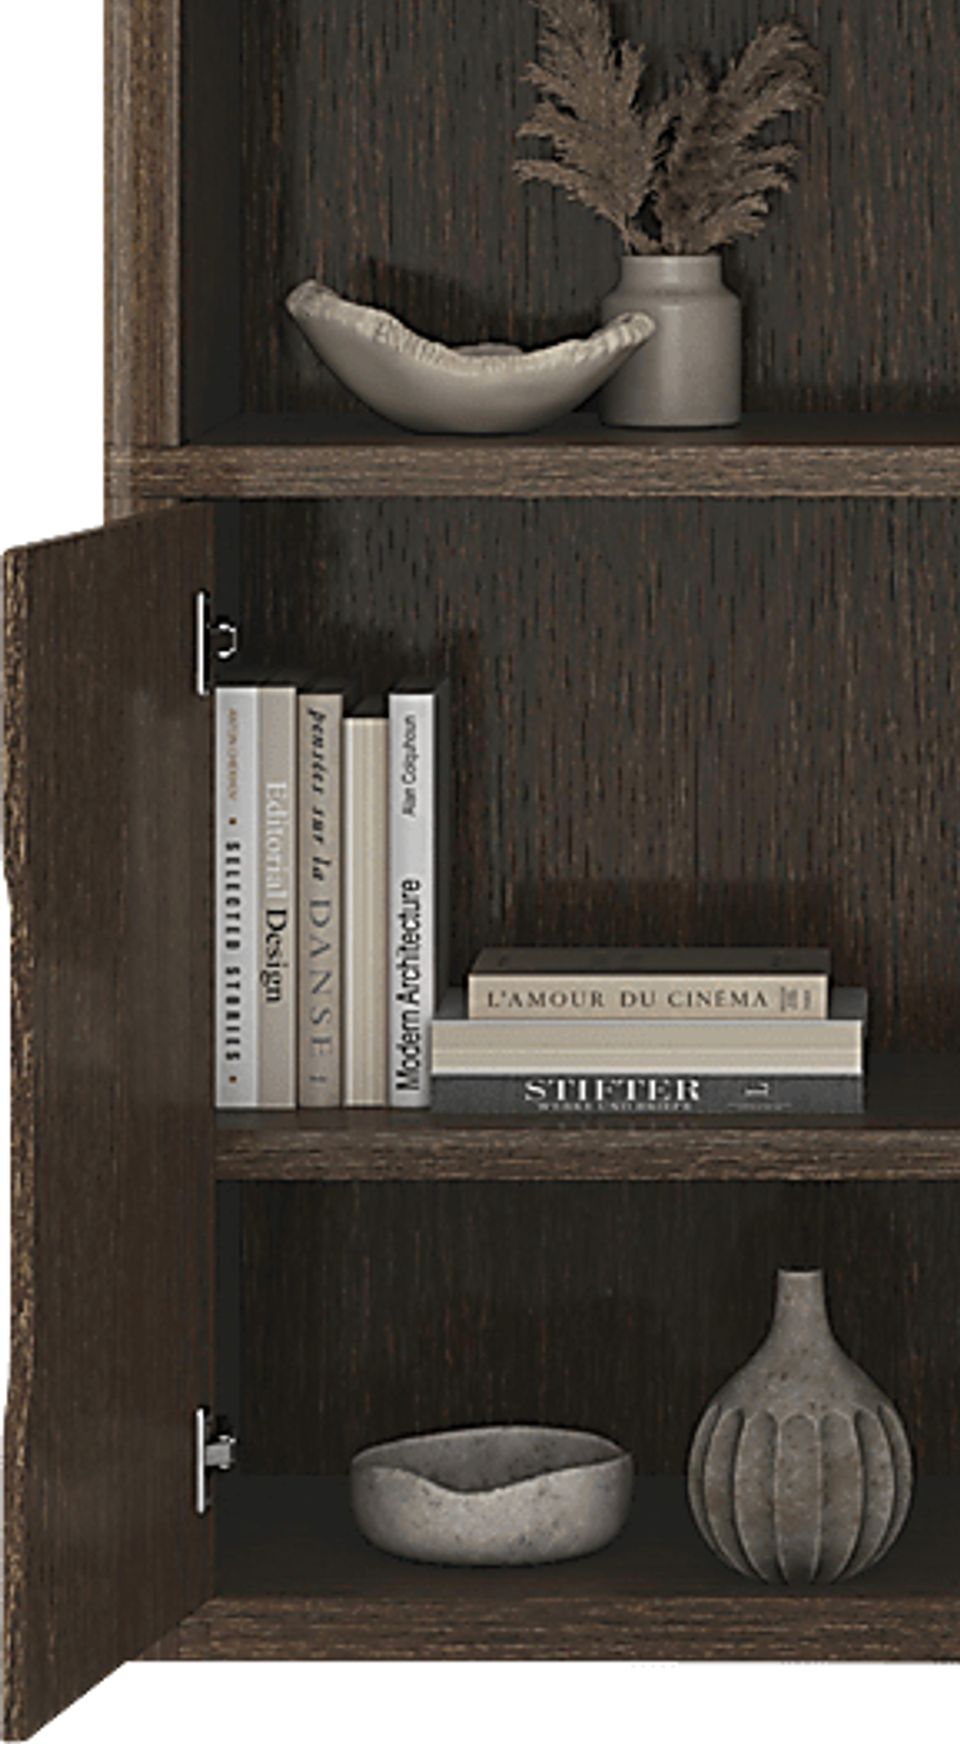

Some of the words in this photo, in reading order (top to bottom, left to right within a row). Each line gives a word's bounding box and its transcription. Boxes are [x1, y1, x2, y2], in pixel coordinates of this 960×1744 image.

[266, 782, 288, 898] Editorial
[312, 808, 325, 844] sur
[312, 857, 332, 881] la
[225, 841, 241, 949] SELECTED
[260, 909, 288, 1003] Design
[309, 899, 332, 1056] DANSE
[396, 880, 420, 1005] Architecture
[225, 966, 241, 1061] STORIES
[486, 990, 605, 1008] L'AMOUR
[620, 992, 657, 1008] DU
[668, 987, 769, 1008] CINÉMA
[396, 1010, 420, 1090] Modern
[524, 1079, 700, 1101] STIFTER
